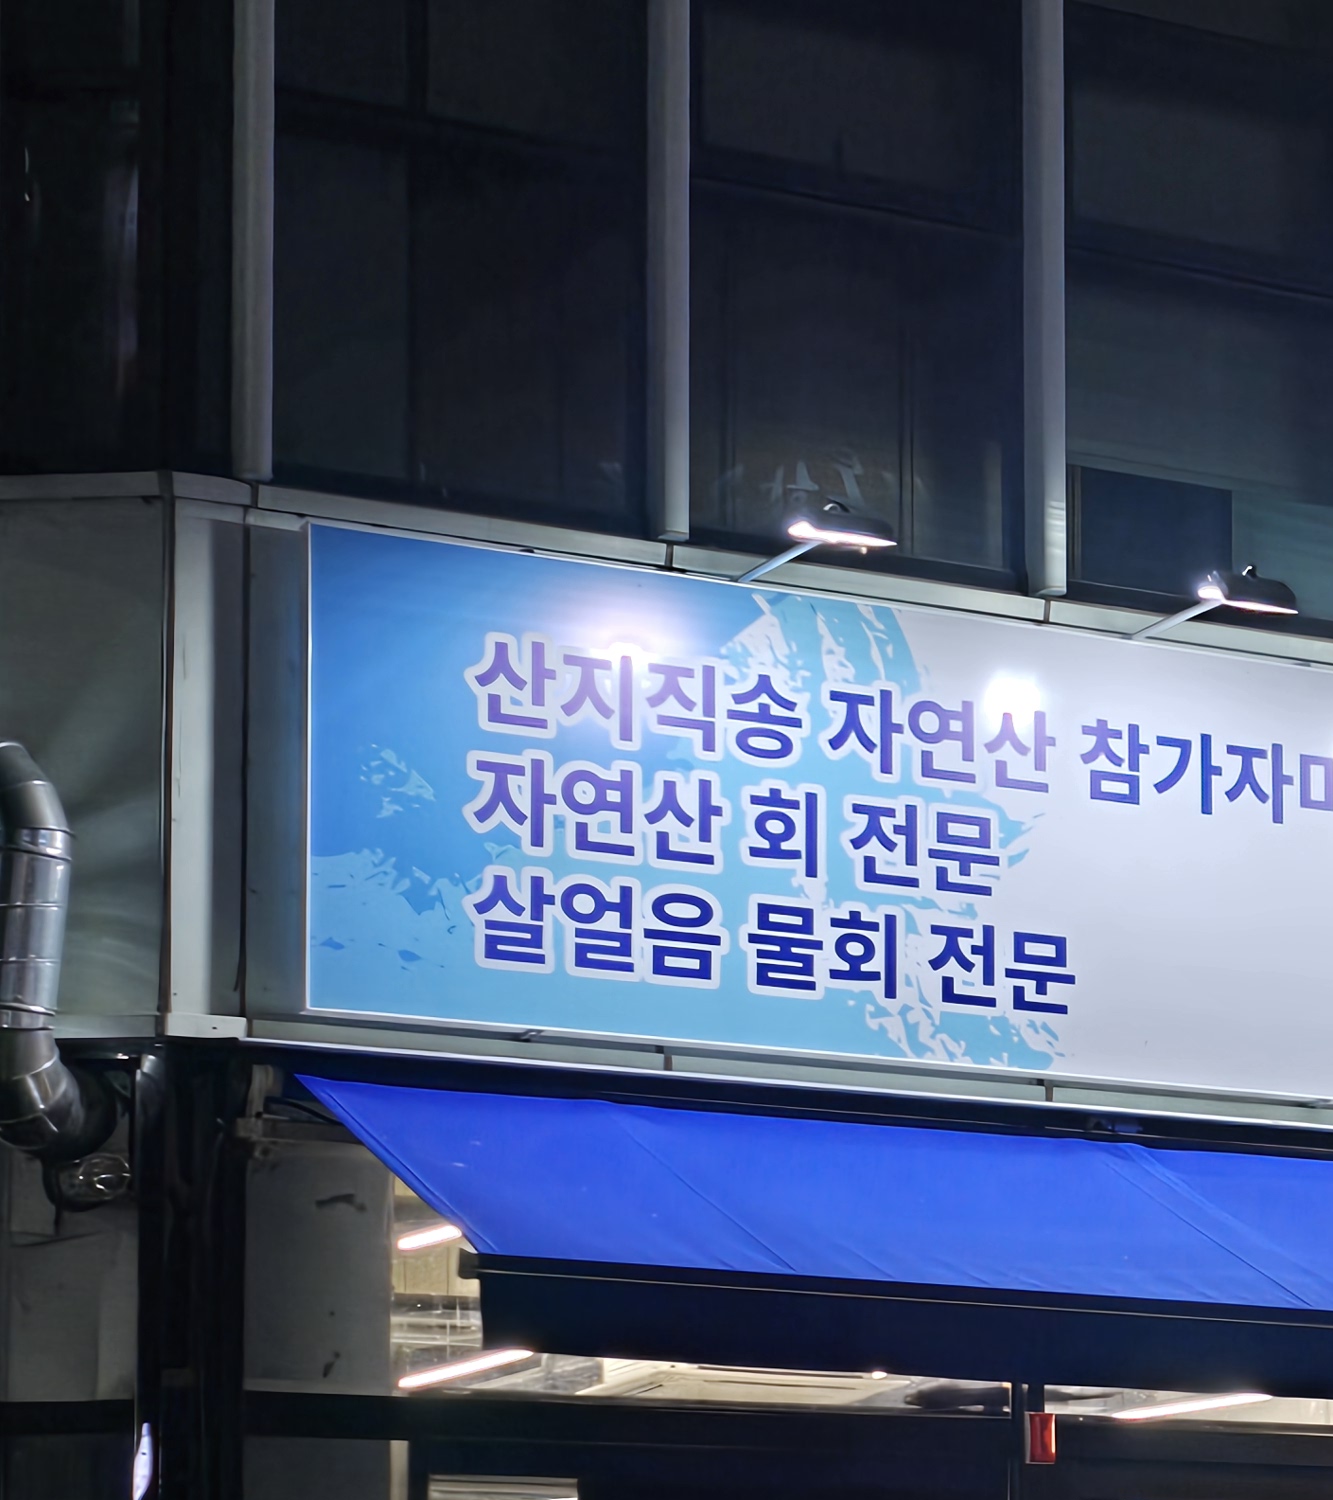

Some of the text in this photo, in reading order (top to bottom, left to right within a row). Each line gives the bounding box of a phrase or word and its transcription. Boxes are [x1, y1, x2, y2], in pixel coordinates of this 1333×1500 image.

[474, 640, 803, 758] 산지직송
[828, 689, 1055, 792] 자연산
[473, 757, 1002, 896] 자연산 회 전문
[474, 874, 1077, 1015] 살얼음 물회 전문
